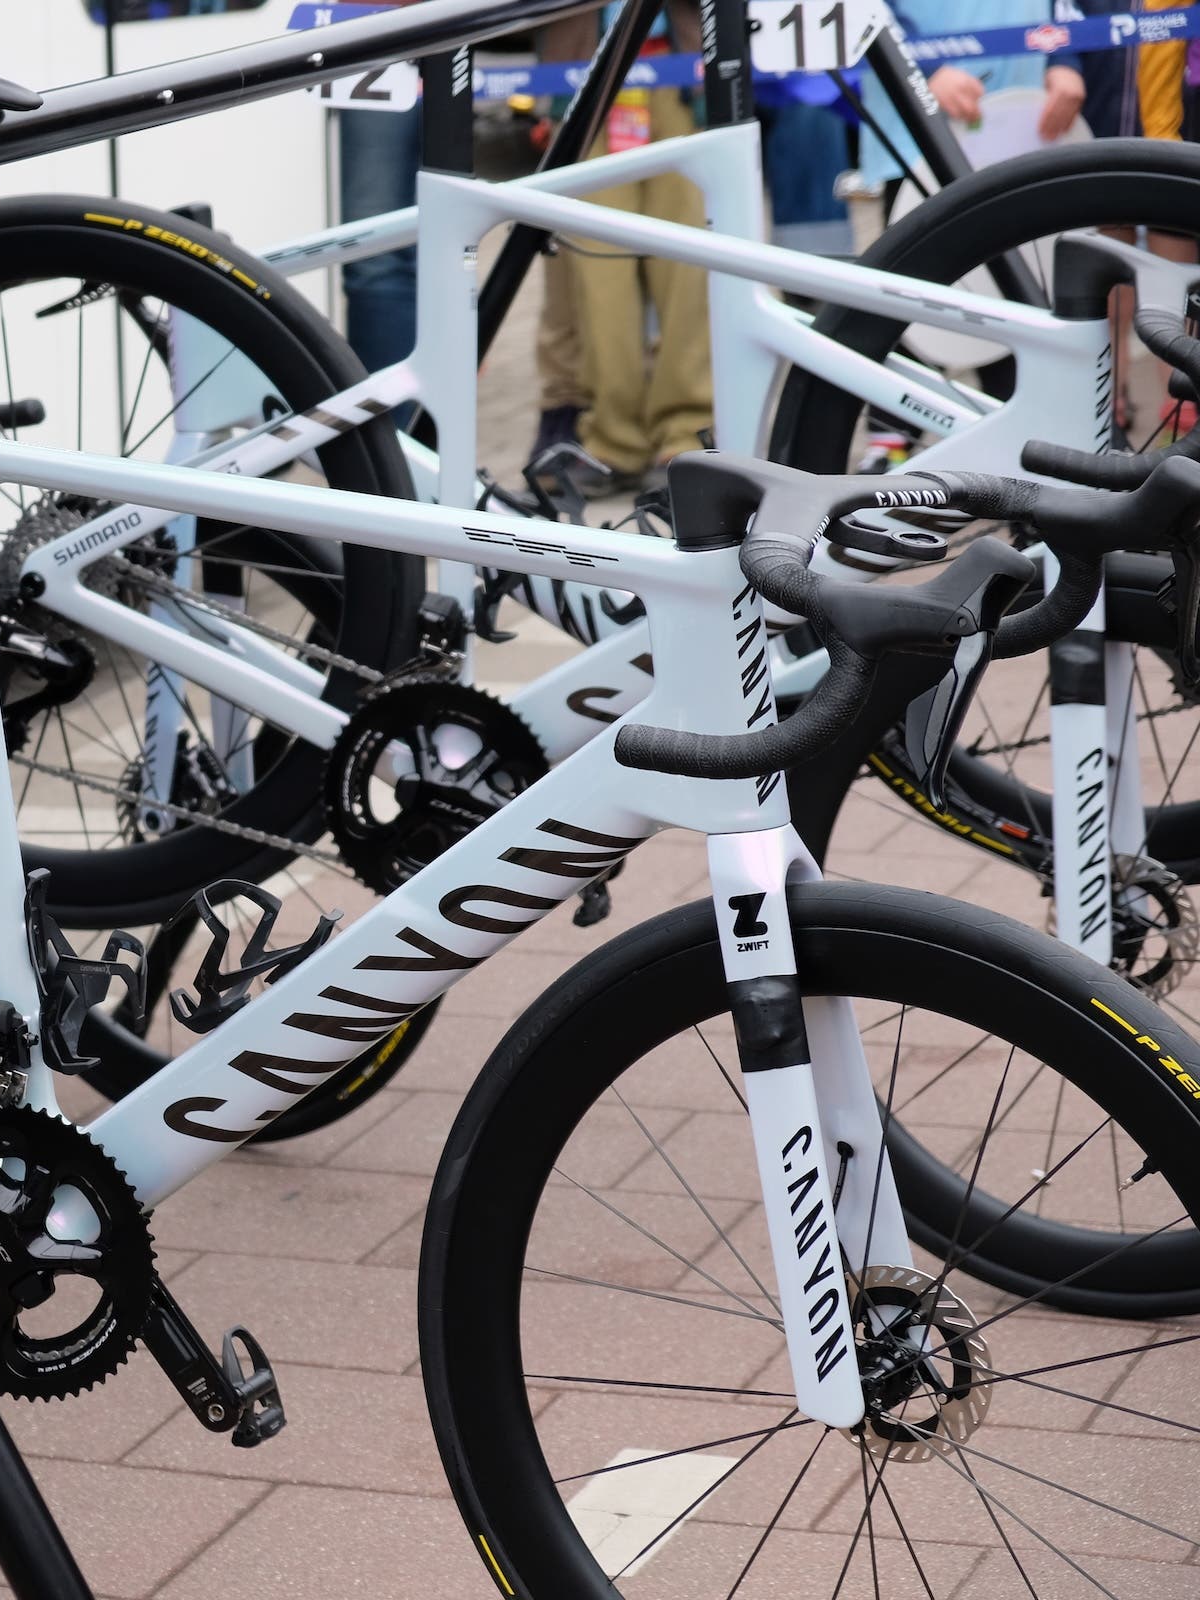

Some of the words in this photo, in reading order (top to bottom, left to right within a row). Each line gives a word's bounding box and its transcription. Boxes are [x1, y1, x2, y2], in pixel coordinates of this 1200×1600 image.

[779, 2, 847, 68] 11
[451, 43, 470, 97] YON
[123, 219, 144, 231] P
[143, 225, 210, 258] ZERO
[875, 490, 948, 507] CANYON
[53, 511, 142, 567] SHIMANO
[732, 582, 780, 808] CANYN
[1076, 746, 1107, 944] CANYON
[736, 939, 770, 953] ZWIFT
[163, 817, 653, 1143] CANYON
[1135, 1035, 1161, 1052] P
[781, 1125, 849, 1384] CANYON
